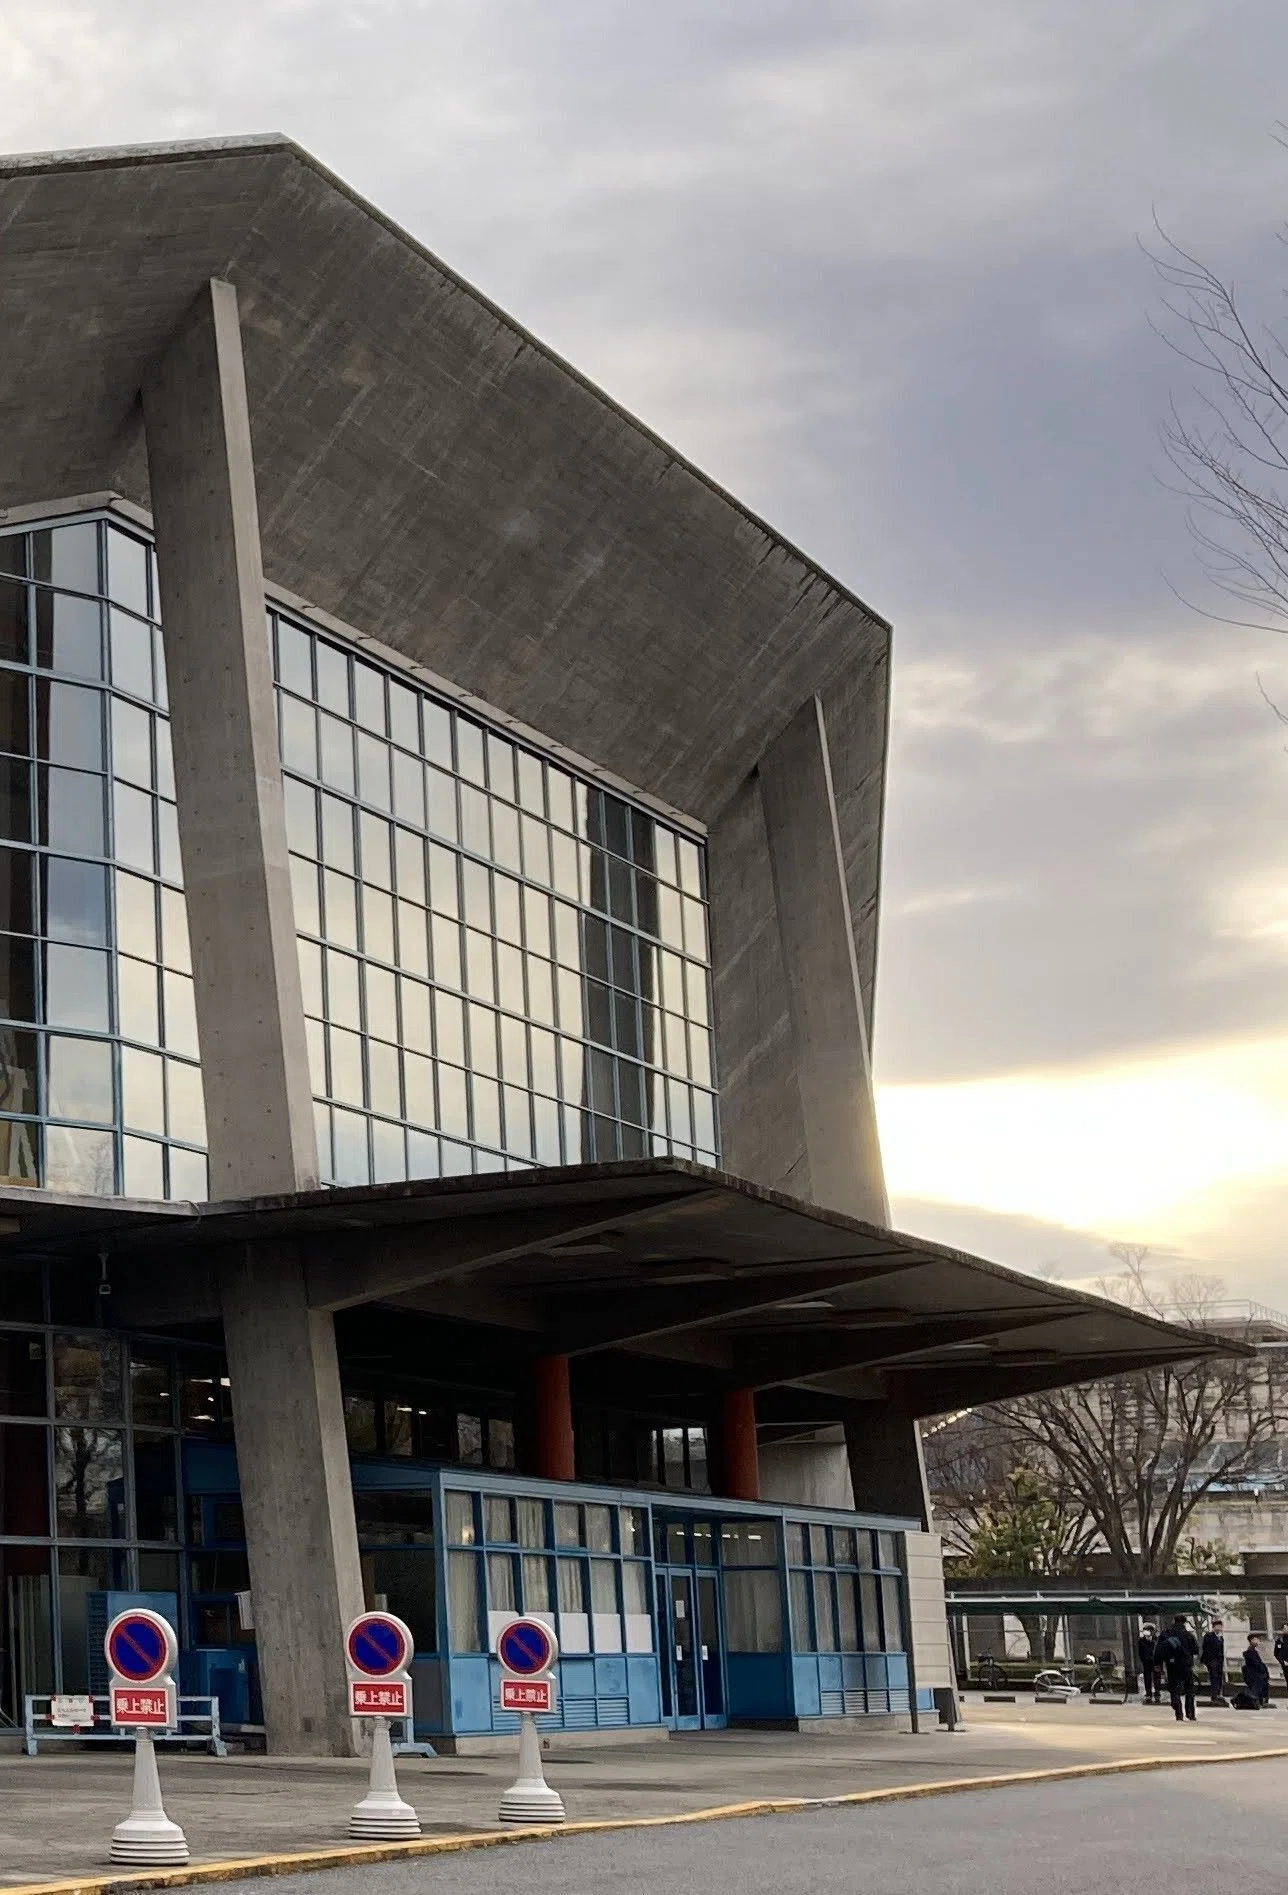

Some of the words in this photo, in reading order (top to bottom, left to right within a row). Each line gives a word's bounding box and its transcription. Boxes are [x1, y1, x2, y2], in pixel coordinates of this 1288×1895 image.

[116, 1697, 165, 1715] 乗上禁止
[354, 1690, 403, 1706] 乗上禁止
